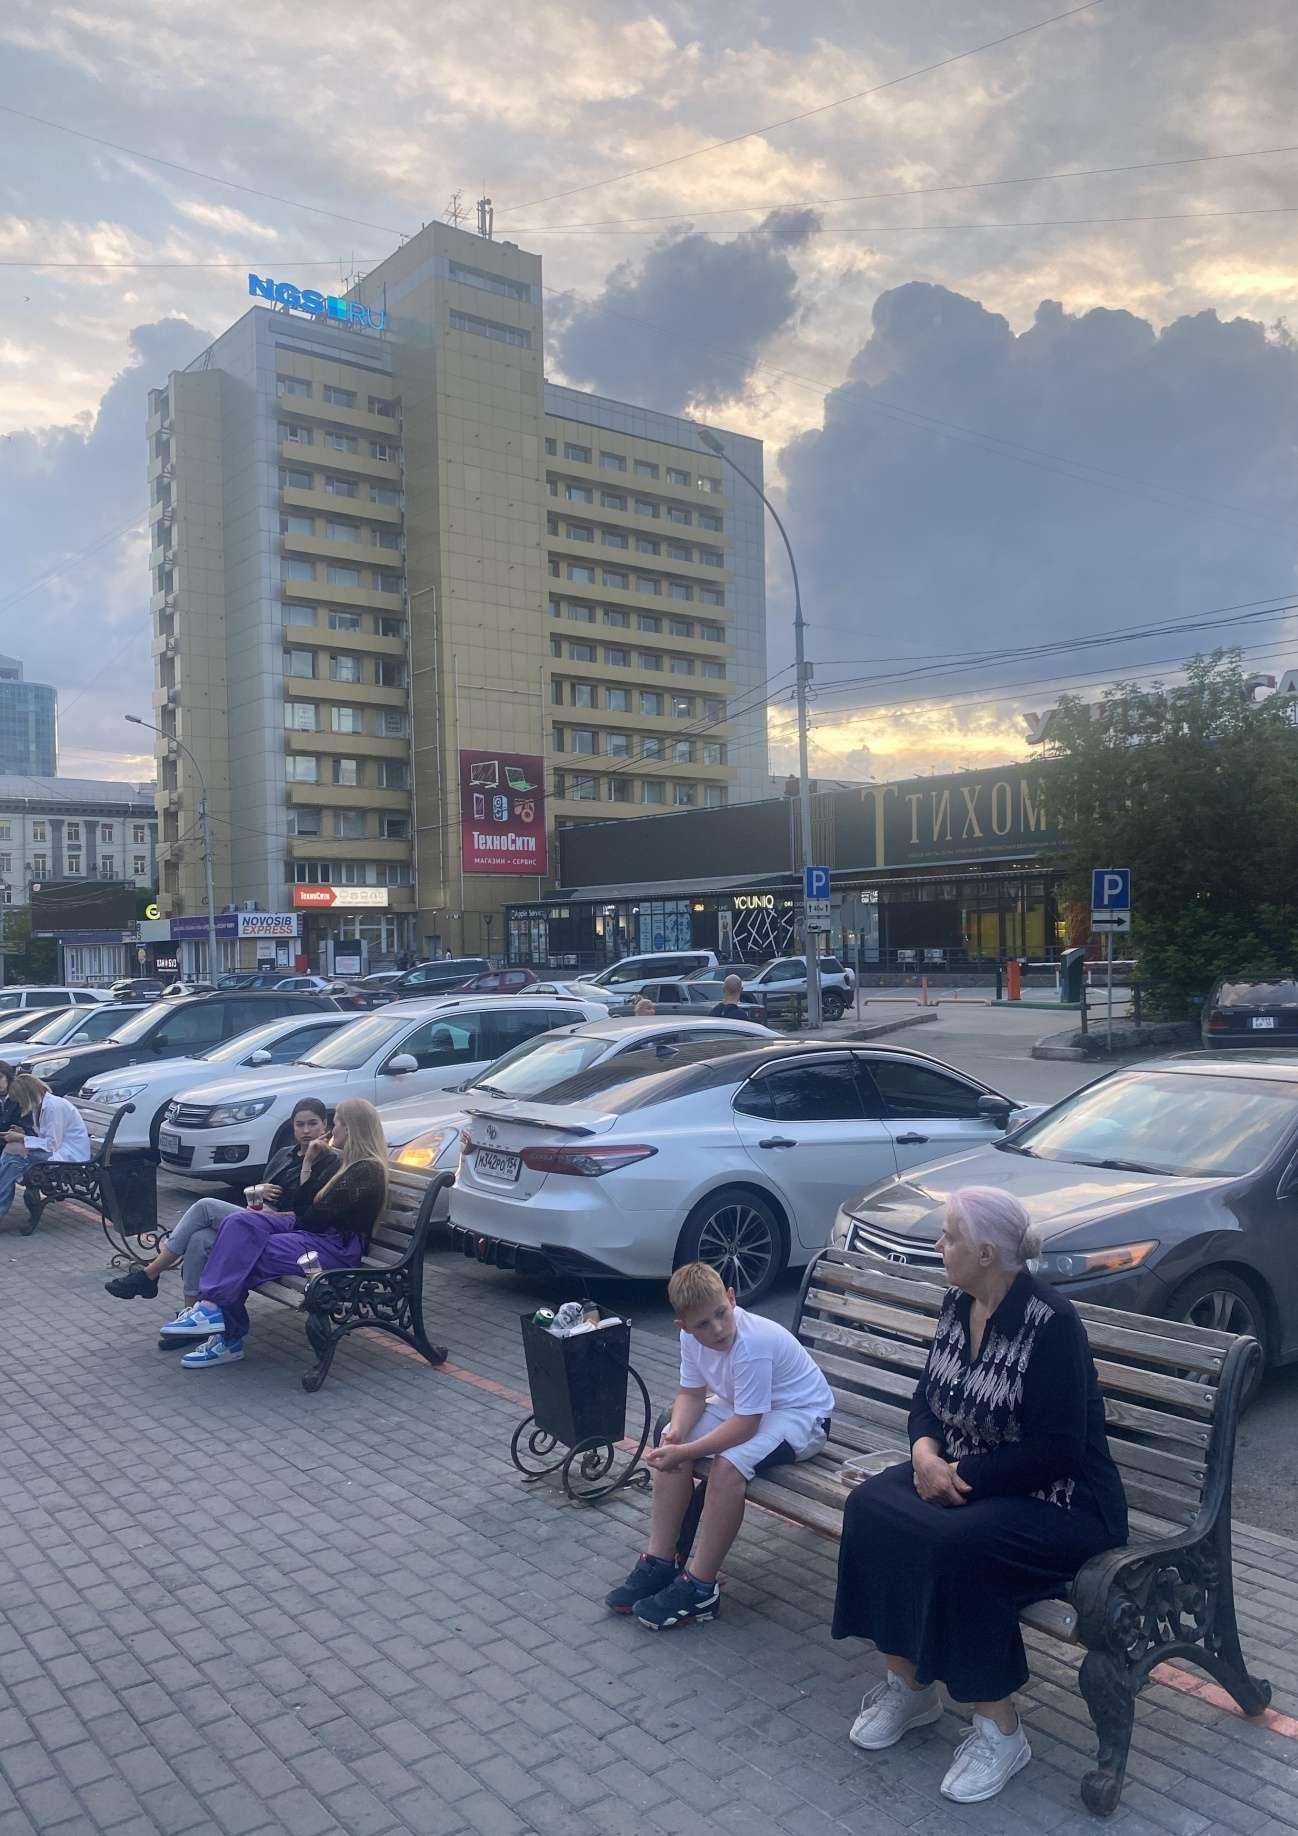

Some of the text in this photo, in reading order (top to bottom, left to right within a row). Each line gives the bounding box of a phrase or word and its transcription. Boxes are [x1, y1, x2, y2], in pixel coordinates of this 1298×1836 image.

[472, 831, 536, 852] ТехноСити
[474, 857, 537, 866] МАГАЗИН СЕРВИС
[812, 870, 826, 896] P
[1103, 874, 1123, 905] P
[242, 916, 293, 926] NOVOSIB
[242, 925, 293, 935] EXPRESS
